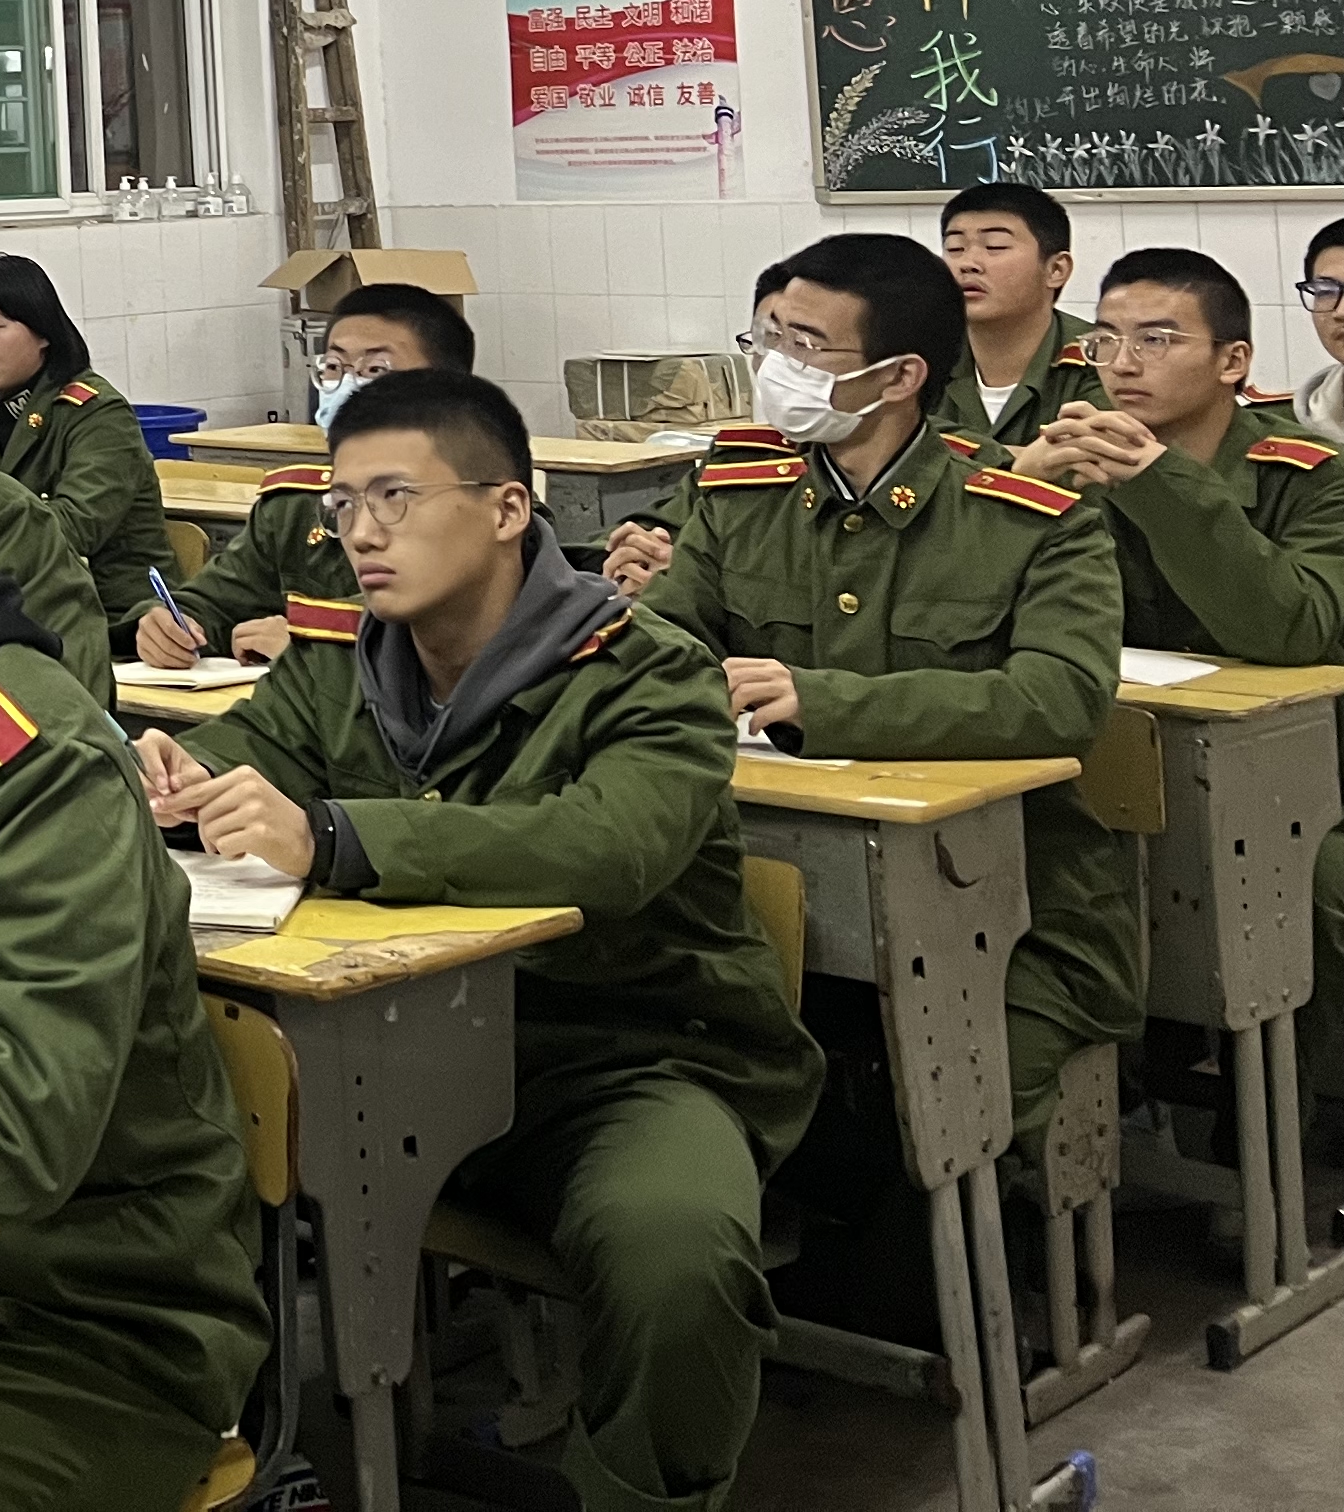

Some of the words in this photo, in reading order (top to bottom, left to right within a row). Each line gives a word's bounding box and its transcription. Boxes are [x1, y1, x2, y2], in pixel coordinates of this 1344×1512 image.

[528, 7, 566, 32] 富强
[575, 4, 613, 29] 民主
[622, 1, 662, 27] 文明
[530, 45, 567, 72] 自由
[576, 43, 615, 70] 平等
[625, 41, 664, 66] 公正
[673, 38, 715, 65] 法治
[530, 85, 569, 112] 爱国
[577, 83, 616, 109] 敬业
[627, 83, 665, 108] 诚信
[676, 81, 716, 107] 友善
